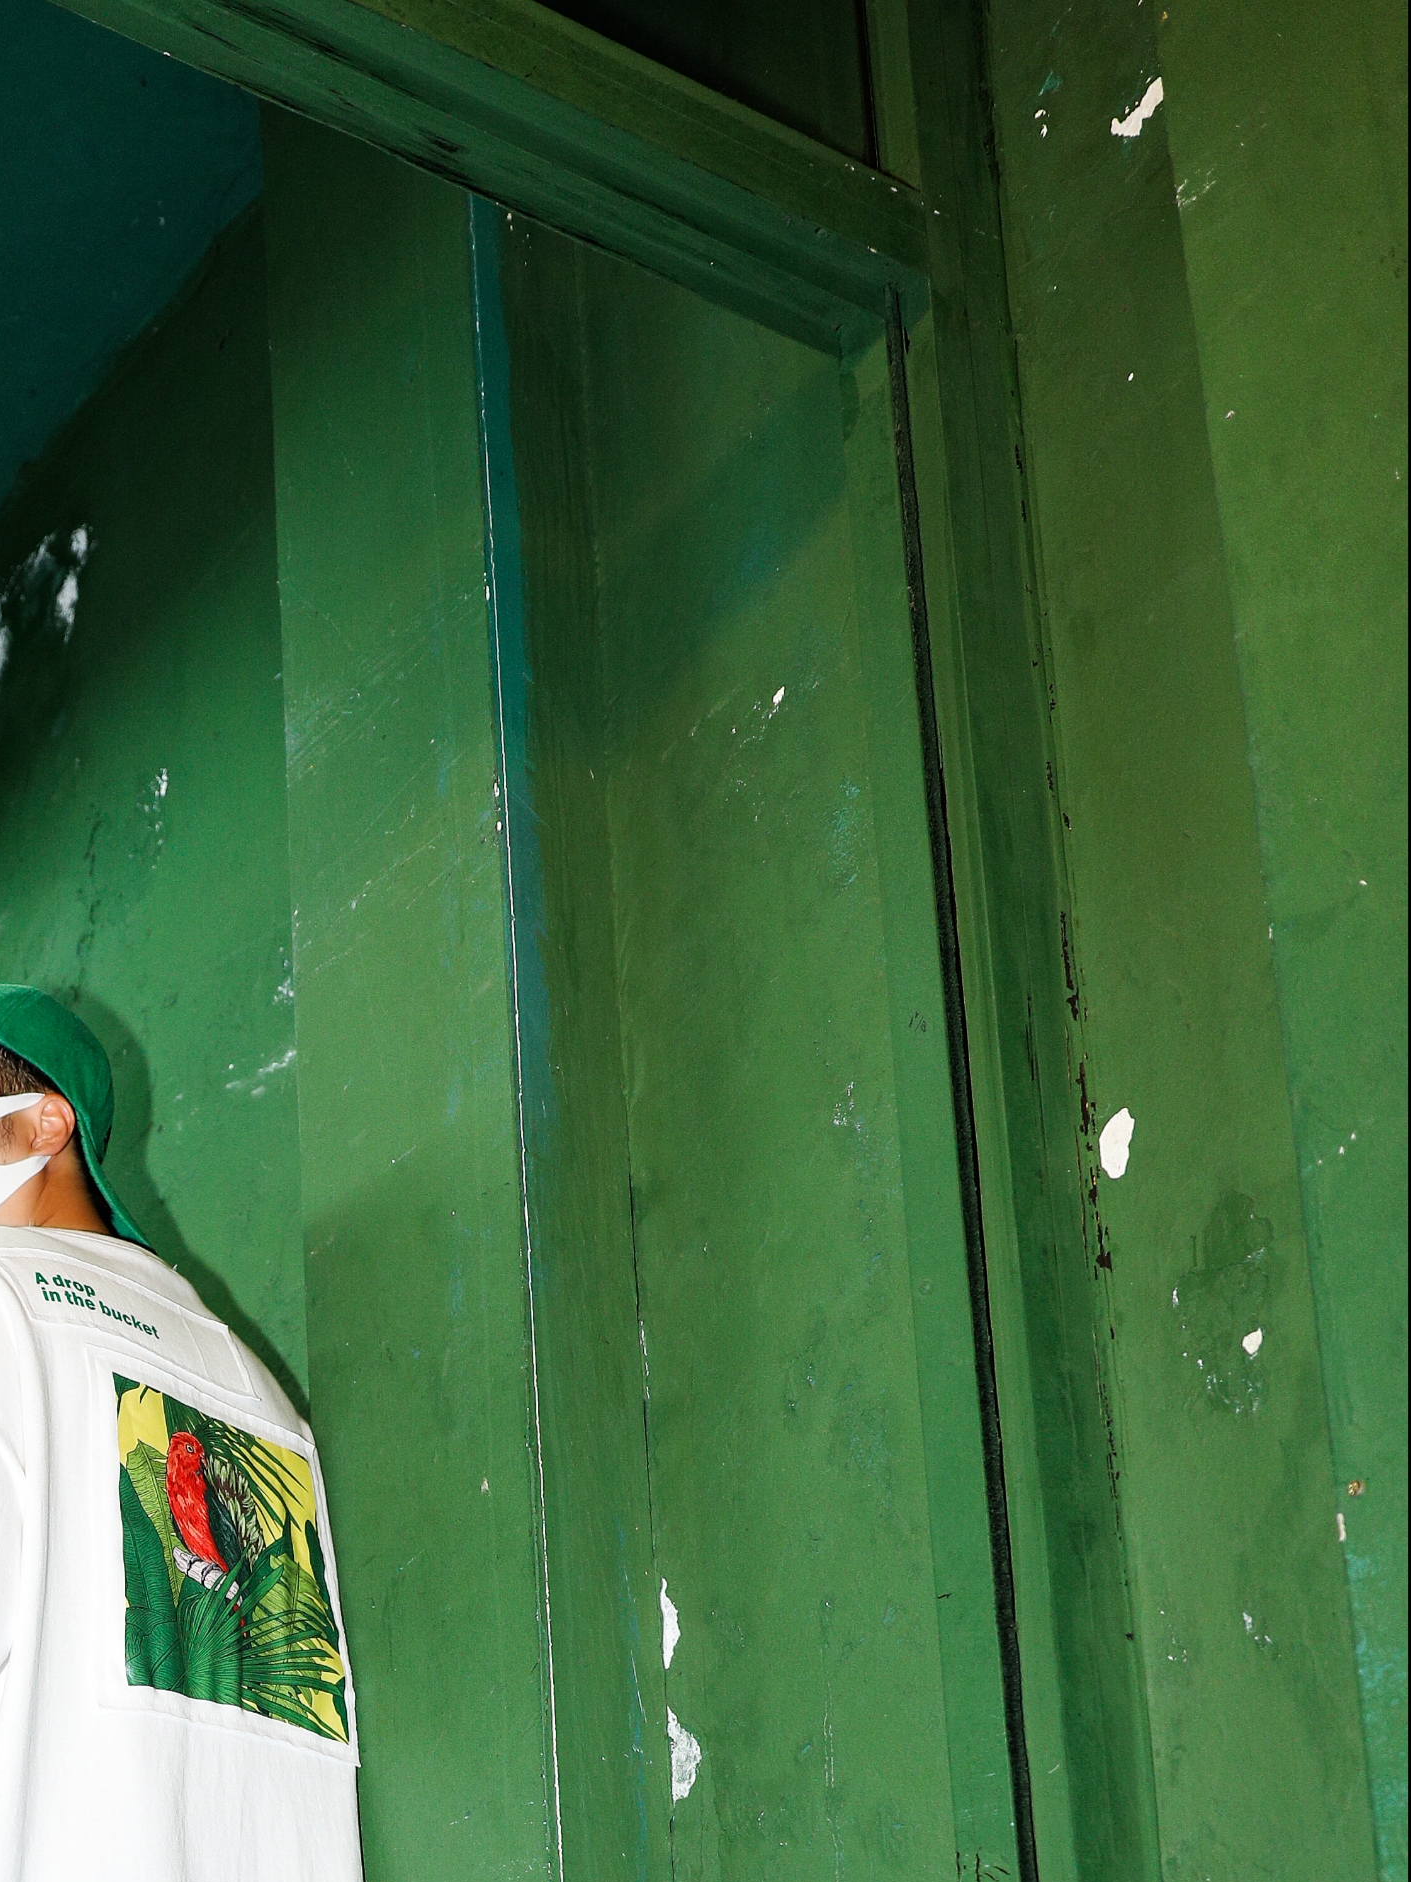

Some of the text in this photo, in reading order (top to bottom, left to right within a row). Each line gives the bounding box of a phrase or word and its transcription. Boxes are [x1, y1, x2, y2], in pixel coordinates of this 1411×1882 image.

[34, 1271, 96, 1297] A drop
[41, 1287, 160, 1340] in the bucket
